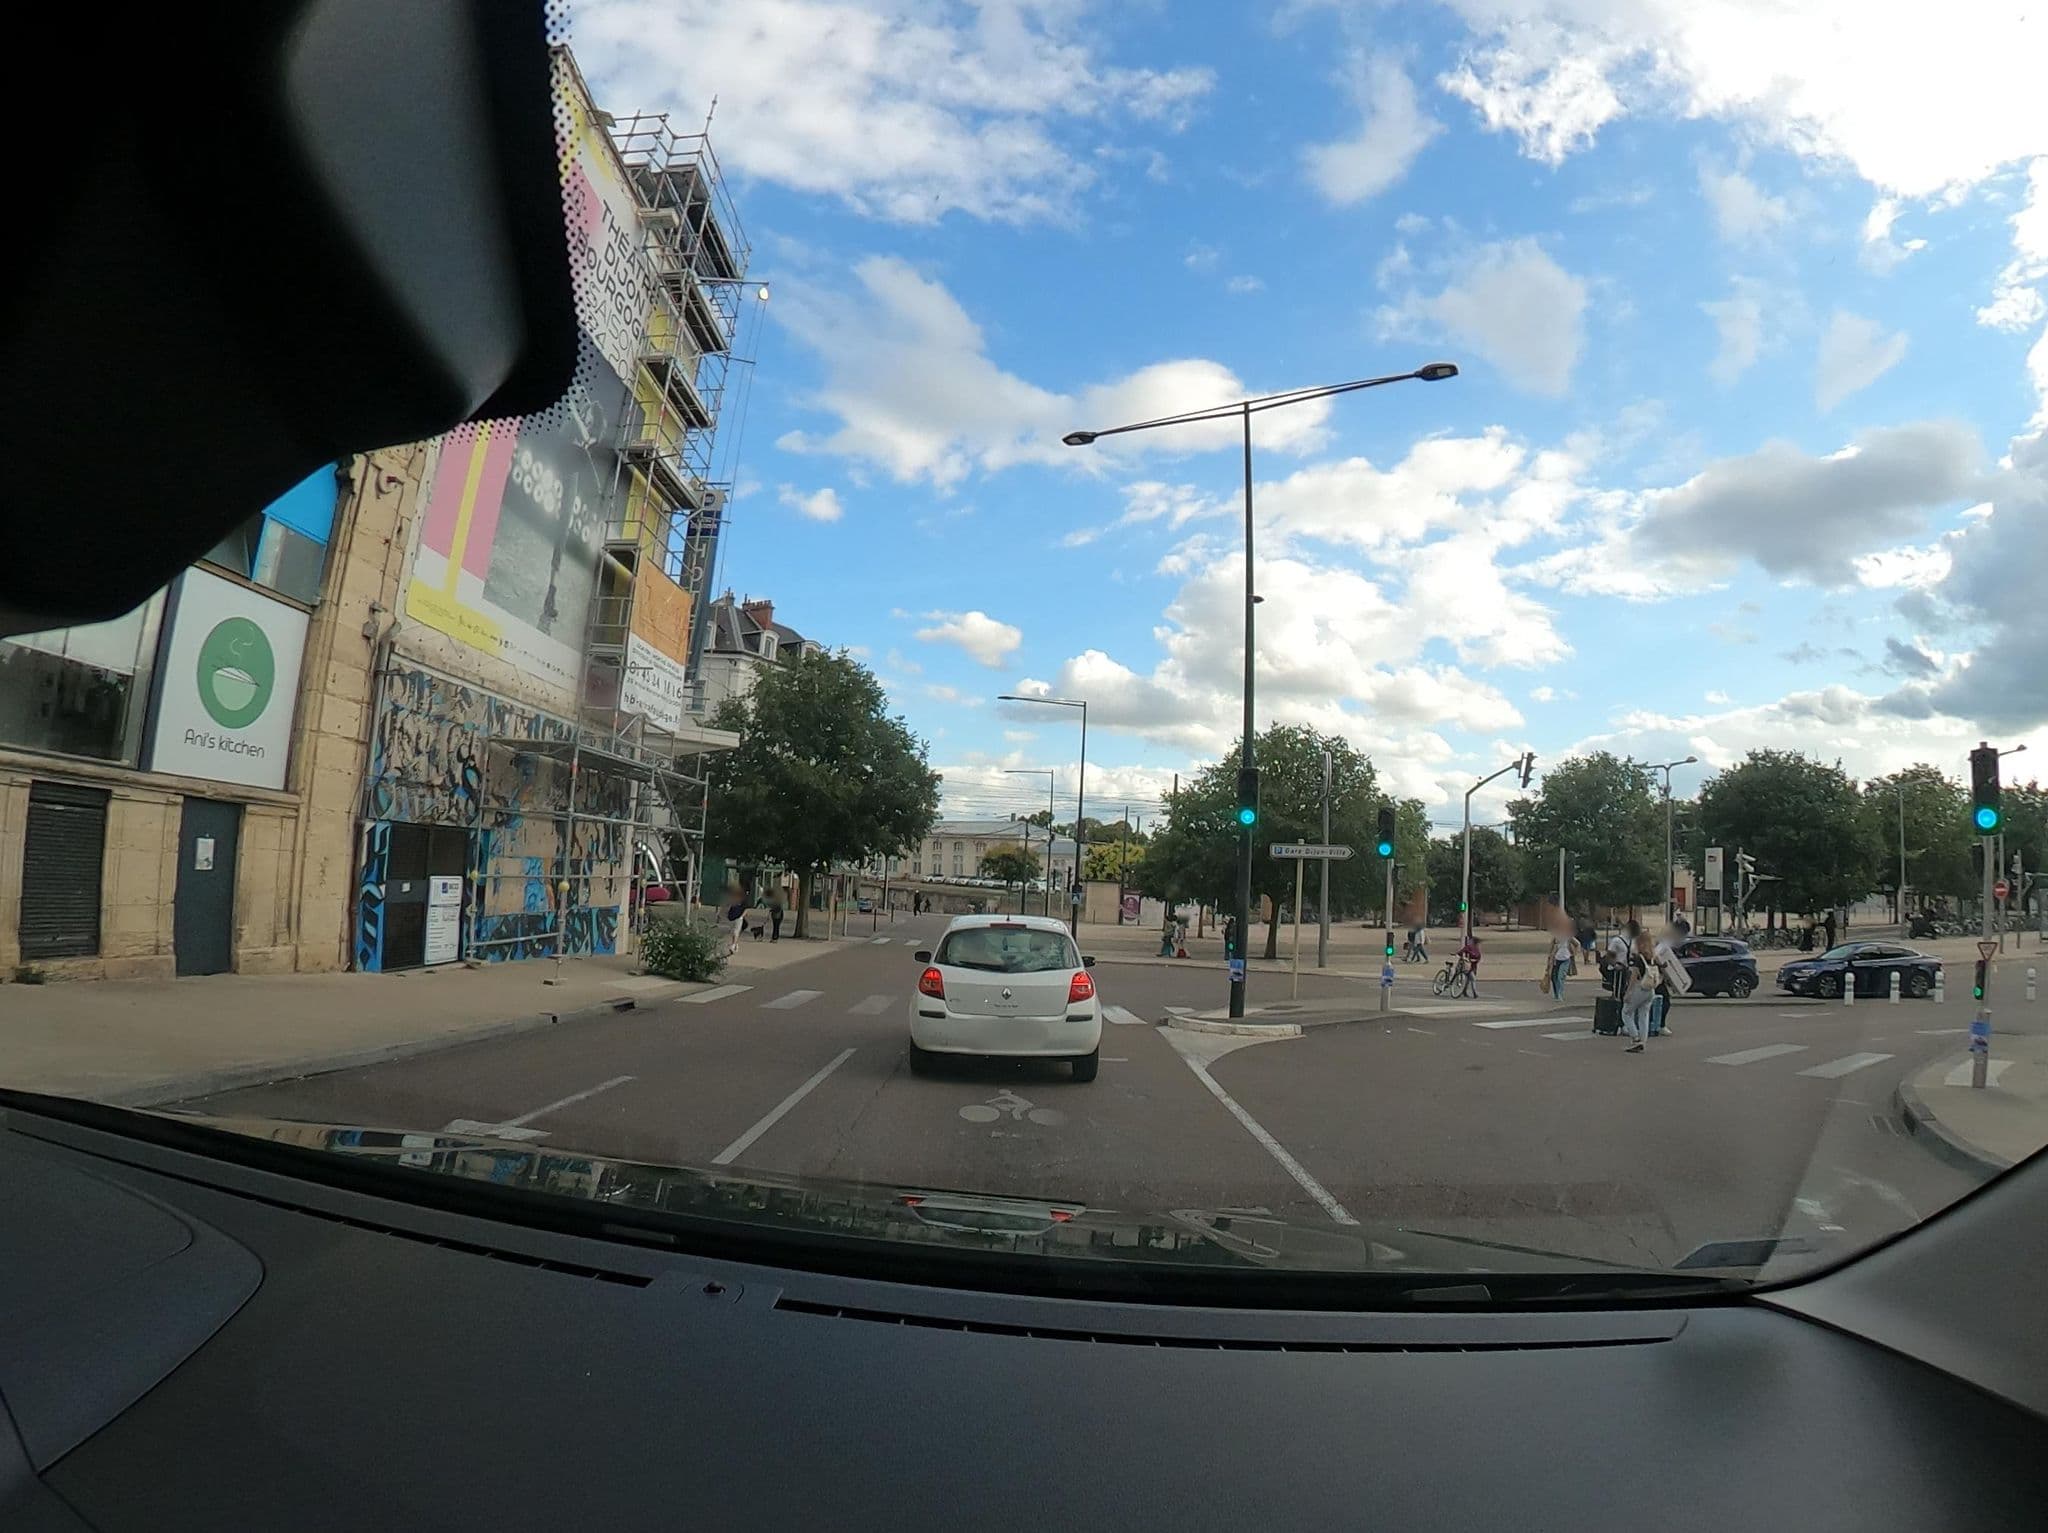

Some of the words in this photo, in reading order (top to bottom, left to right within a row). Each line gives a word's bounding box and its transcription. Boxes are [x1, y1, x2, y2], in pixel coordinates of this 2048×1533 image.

[604, 241, 645, 316] DIJON
[184, 728, 216, 749] Ani's
[218, 735, 265, 758] kitchen
